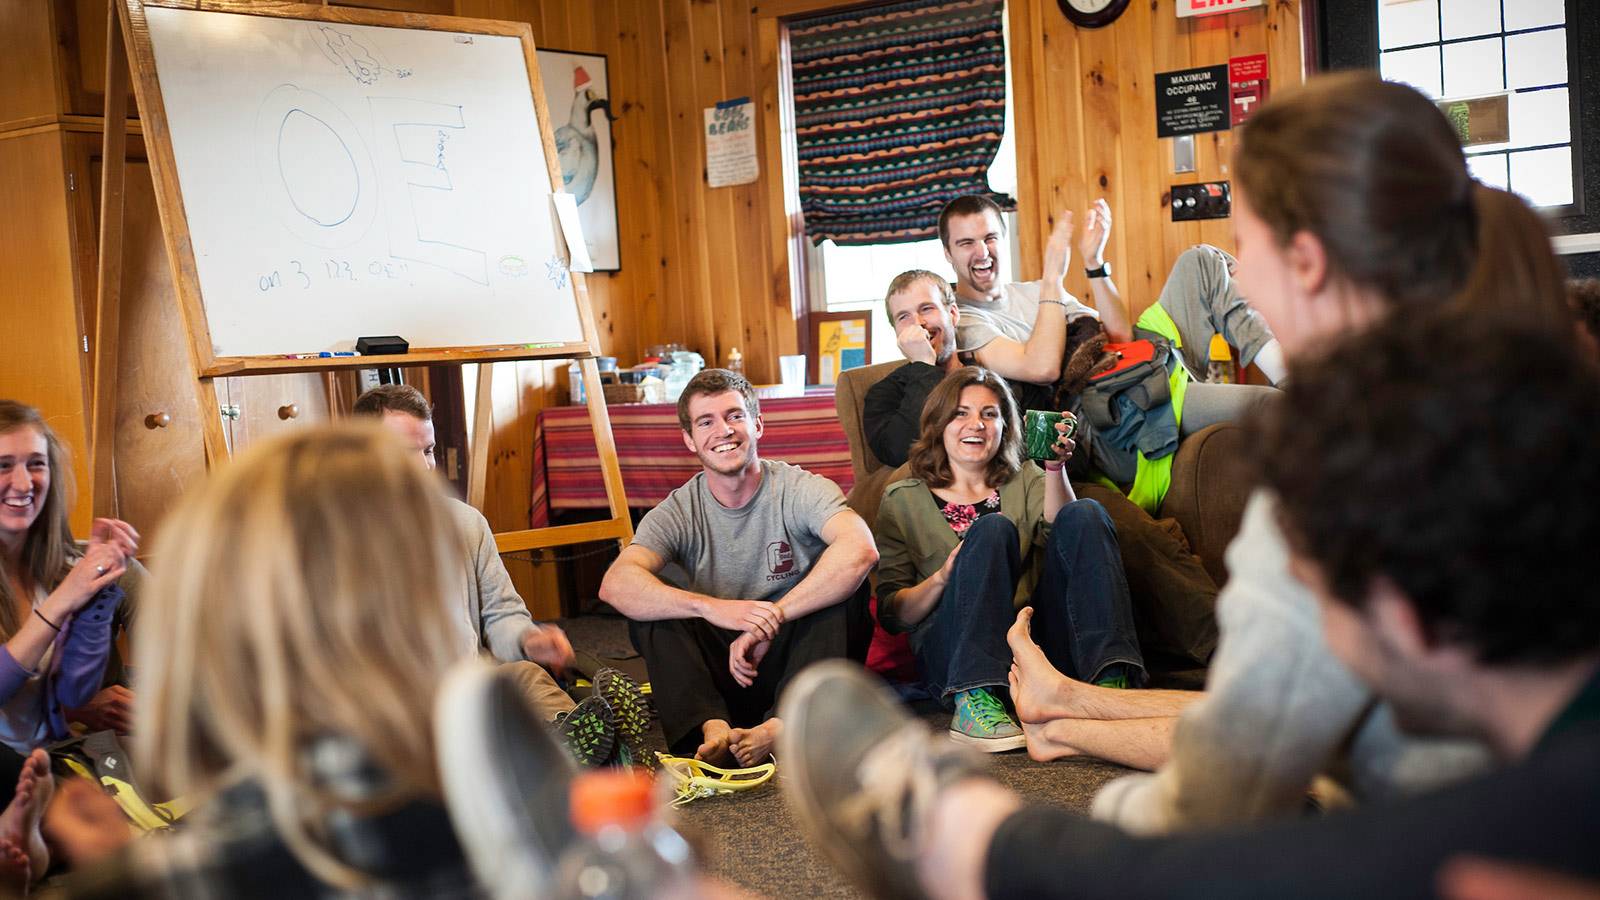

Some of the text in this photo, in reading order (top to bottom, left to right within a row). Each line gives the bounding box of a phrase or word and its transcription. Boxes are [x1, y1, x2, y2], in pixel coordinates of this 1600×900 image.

[1171, 72, 1211, 84] MAXIMUM
[1166, 82, 1217, 96] OCCUPANCY
[766, 570, 800, 581] CYCLING
